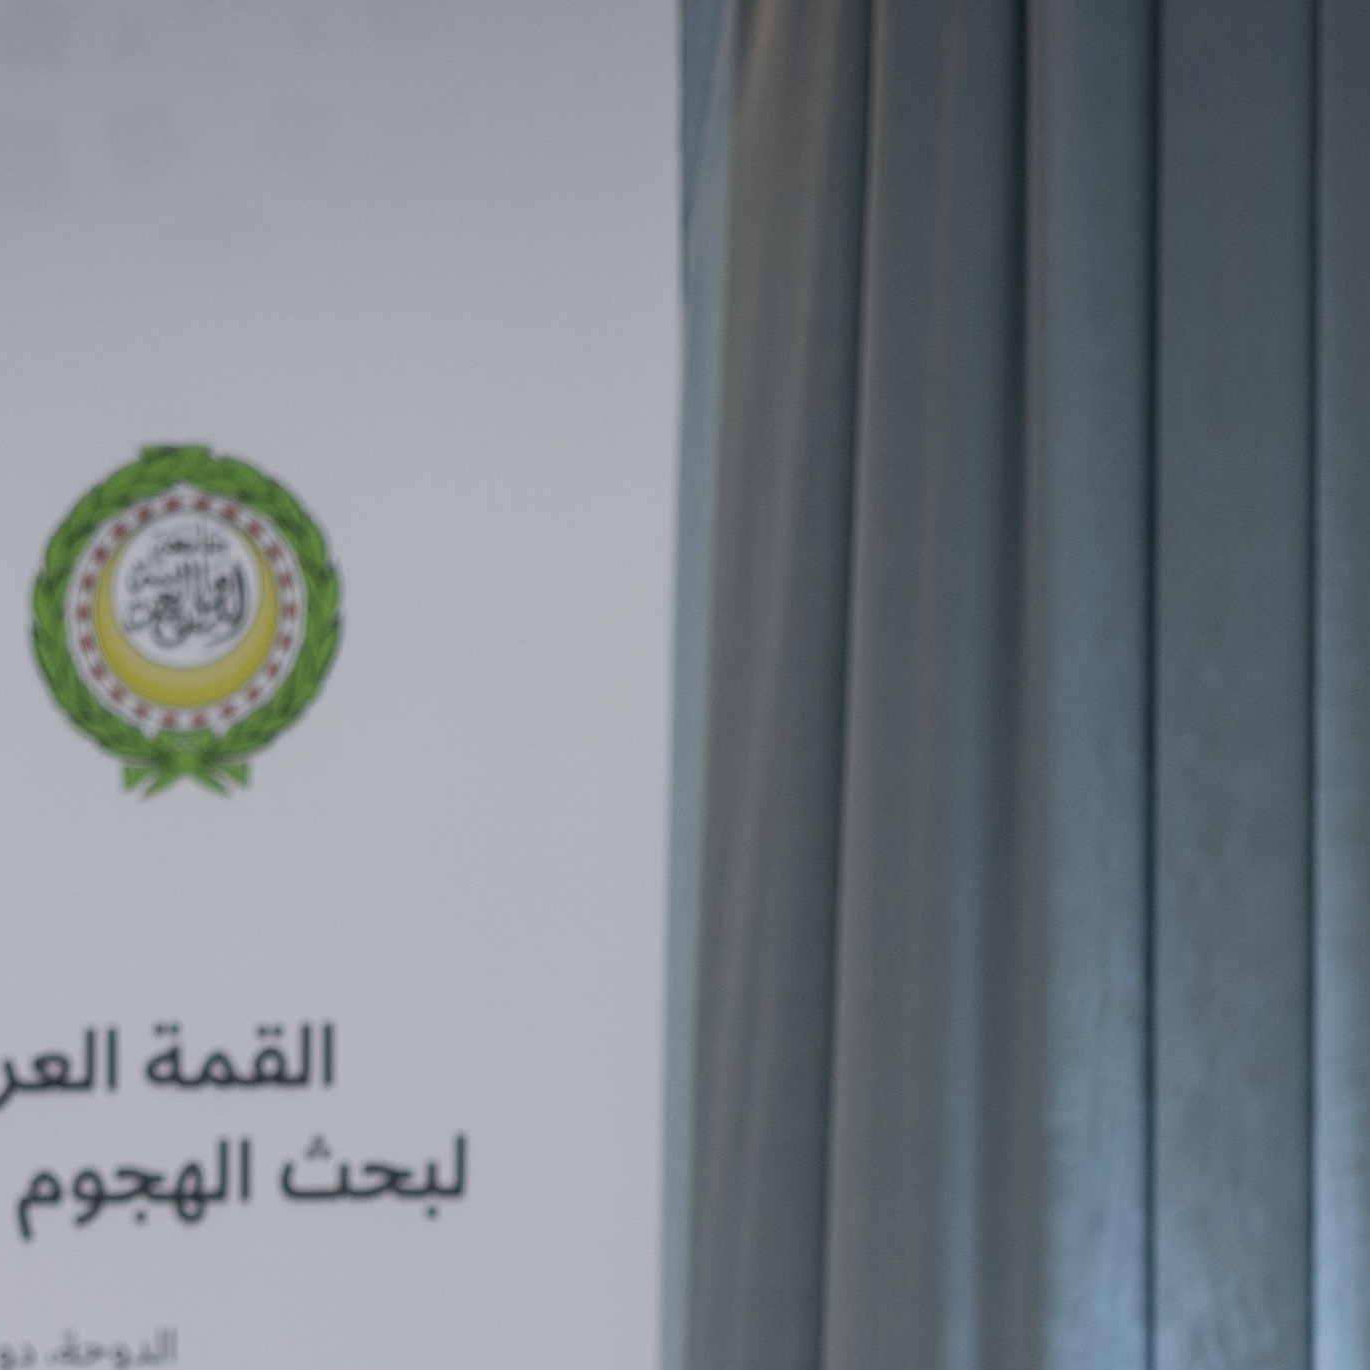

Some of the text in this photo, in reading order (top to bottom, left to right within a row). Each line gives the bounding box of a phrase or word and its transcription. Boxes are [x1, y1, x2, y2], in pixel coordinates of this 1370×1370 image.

[142, 1021, 337, 1093] القمة
[14, 1136, 254, 1244] الهجوم
[277, 1132, 469, 1221] لبحث
